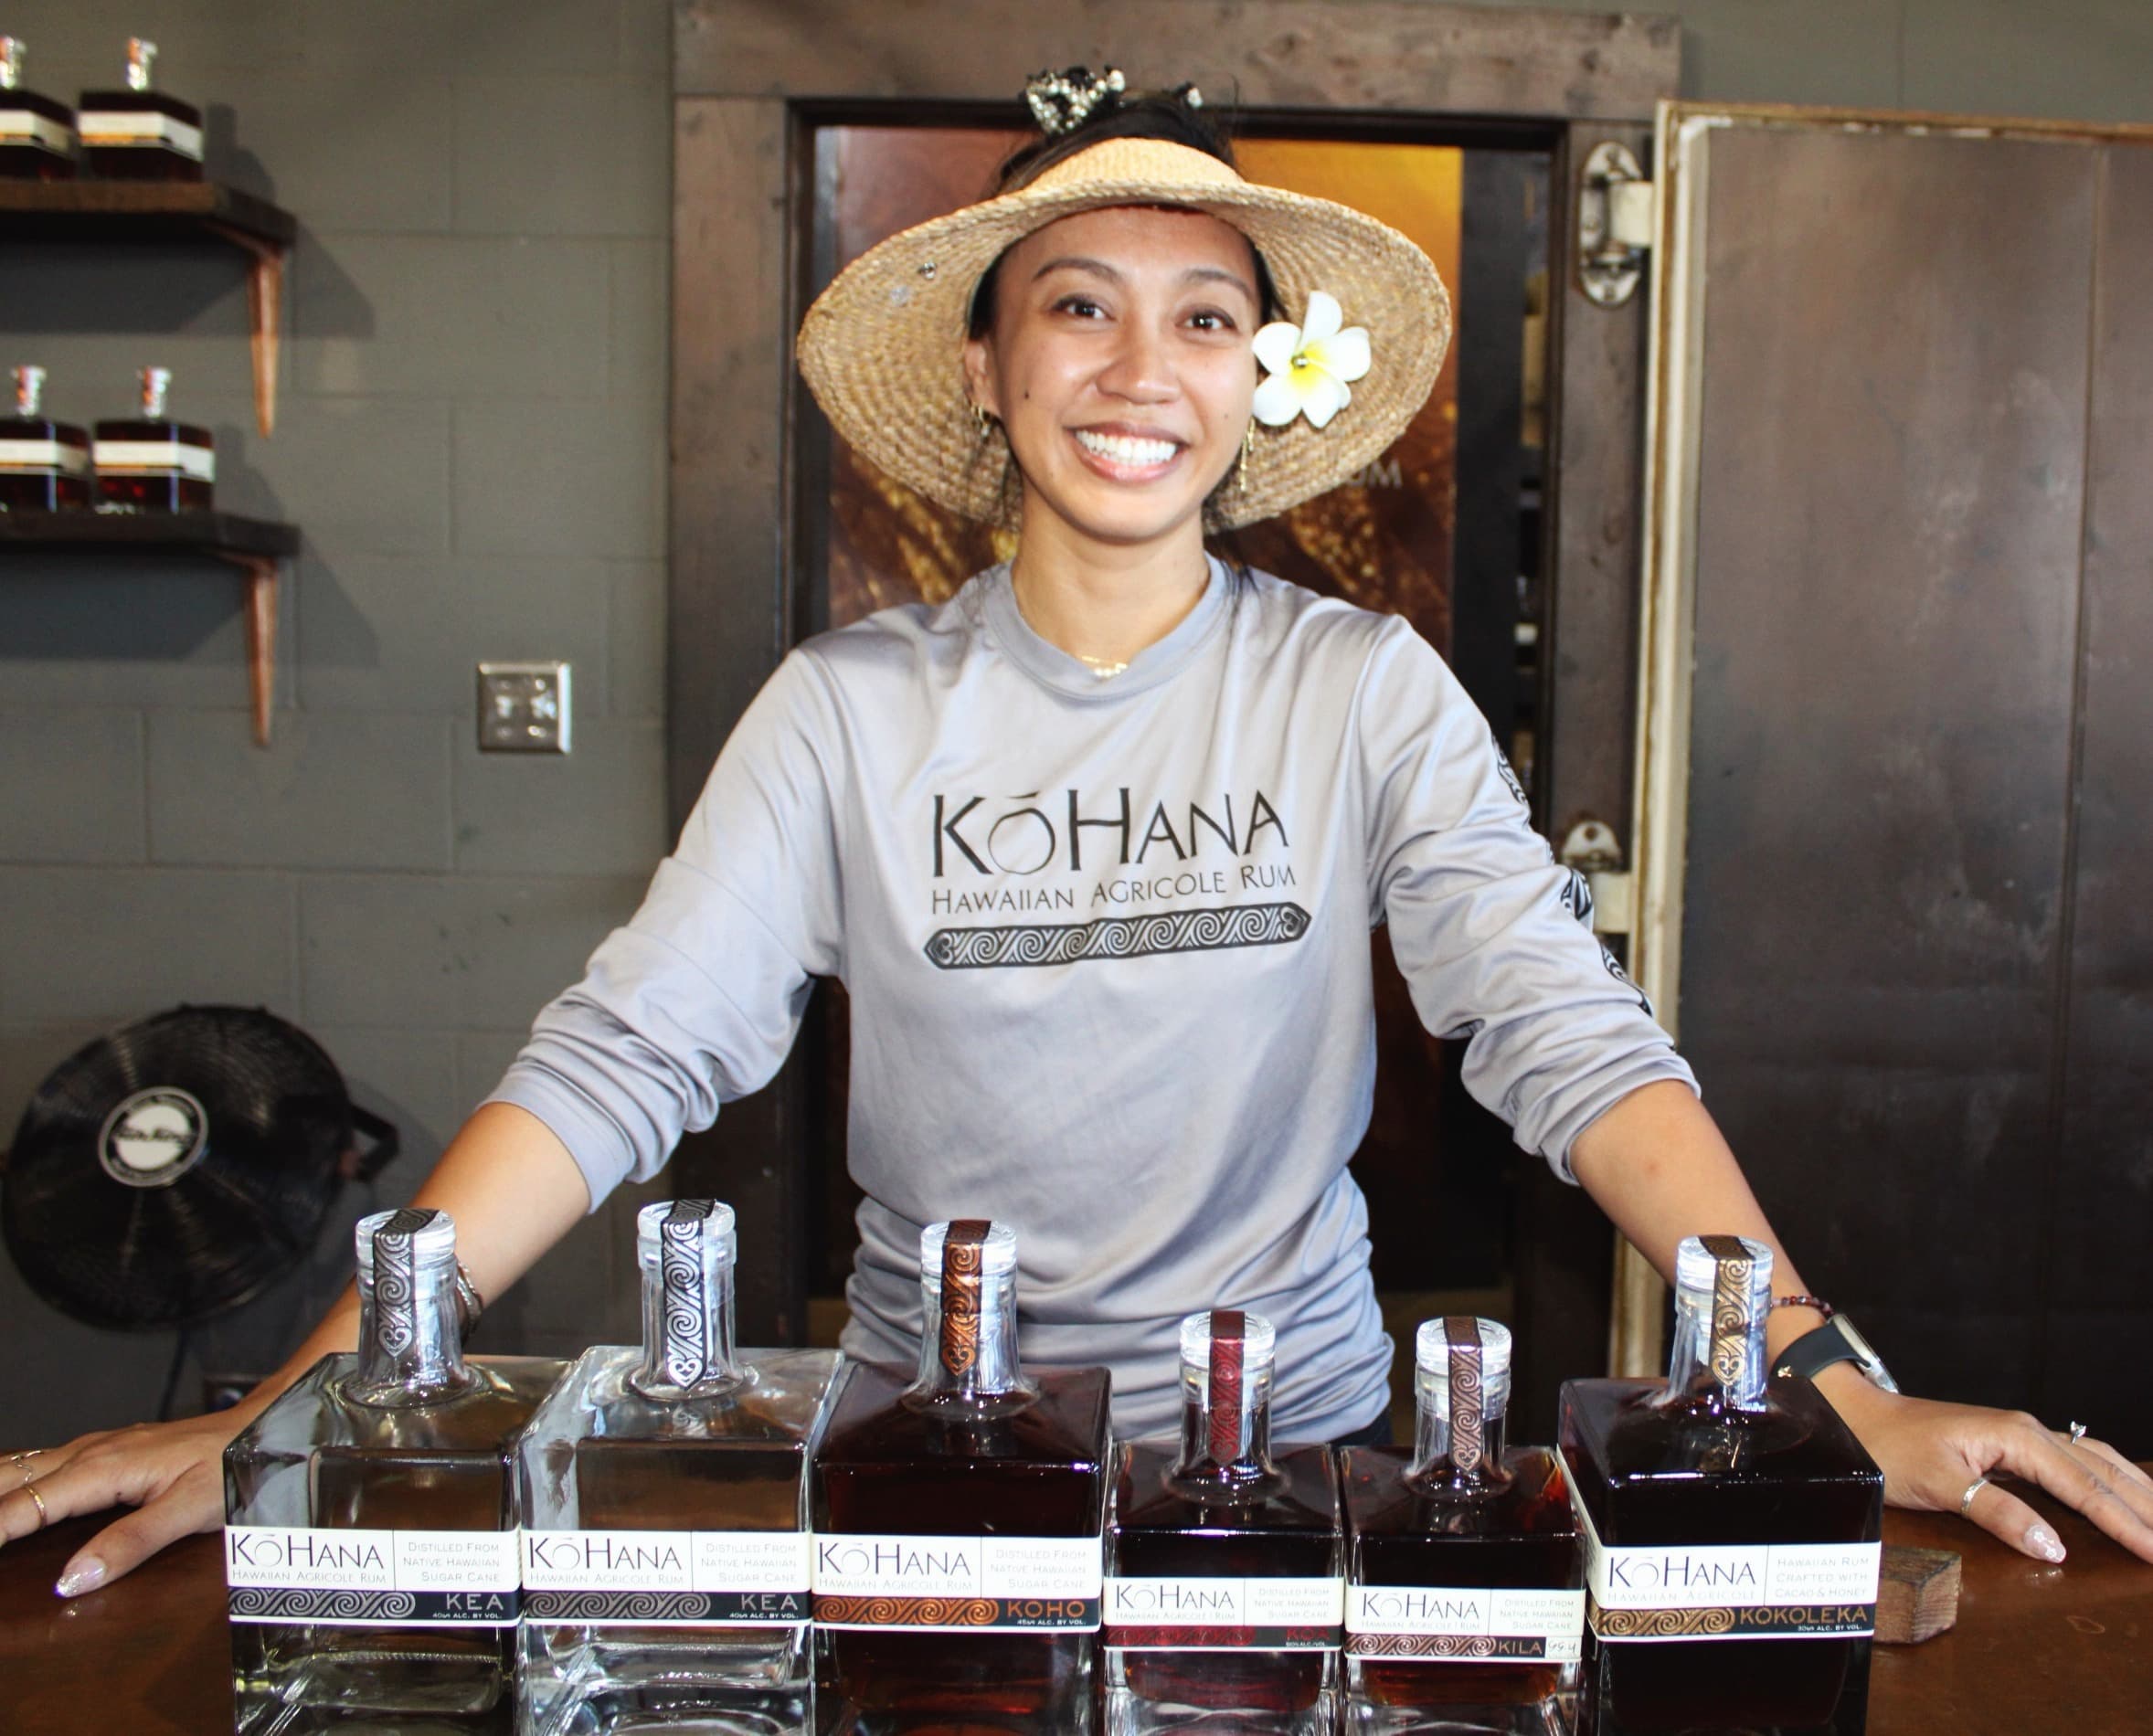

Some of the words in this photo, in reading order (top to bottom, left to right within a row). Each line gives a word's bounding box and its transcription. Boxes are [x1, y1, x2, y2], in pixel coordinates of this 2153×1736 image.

[931, 888, 1075, 915] HAWAIIAN
[1090, 871, 1227, 907] AGRICOLE
[1240, 863, 1297, 891] RUM
[408, 1541, 463, 1553] DISTILLED
[467, 1542, 500, 1553] FROM
[764, 1542, 797, 1553] FROM
[403, 1557, 442, 1567] NATIVE
[446, 1557, 501, 1568] HAWAIIAN
[701, 1557, 739, 1568] NATIVE
[744, 1557, 797, 1568] HAWAIIAN
[1777, 1556, 1837, 1567] HAWAIIAN
[1841, 1556, 1870, 1566] RUM
[990, 1563, 1029, 1573] NATIVE
[360, 1573, 387, 1584] RUM
[421, 1571, 462, 1583] SUGAR
[467, 1571, 501, 1583] CANE
[658, 1573, 684, 1585] RUM
[718, 1572, 760, 1583] SUGAR
[765, 1572, 797, 1583] CANE
[1776, 1572, 1834, 1583] CRAFTED
[1839, 1572, 1868, 1582] WITH
[1776, 1588, 1814, 1598] CACAO
[1829, 1586, 1866, 1597] HONEY
[446, 1593, 504, 1611] KEA
[740, 1593, 799, 1611] KEA
[1007, 1600, 1086, 1618] KOHO
[1740, 1606, 1867, 1625] KOKOLEKA
[1499, 1640, 1543, 1655] KILA
